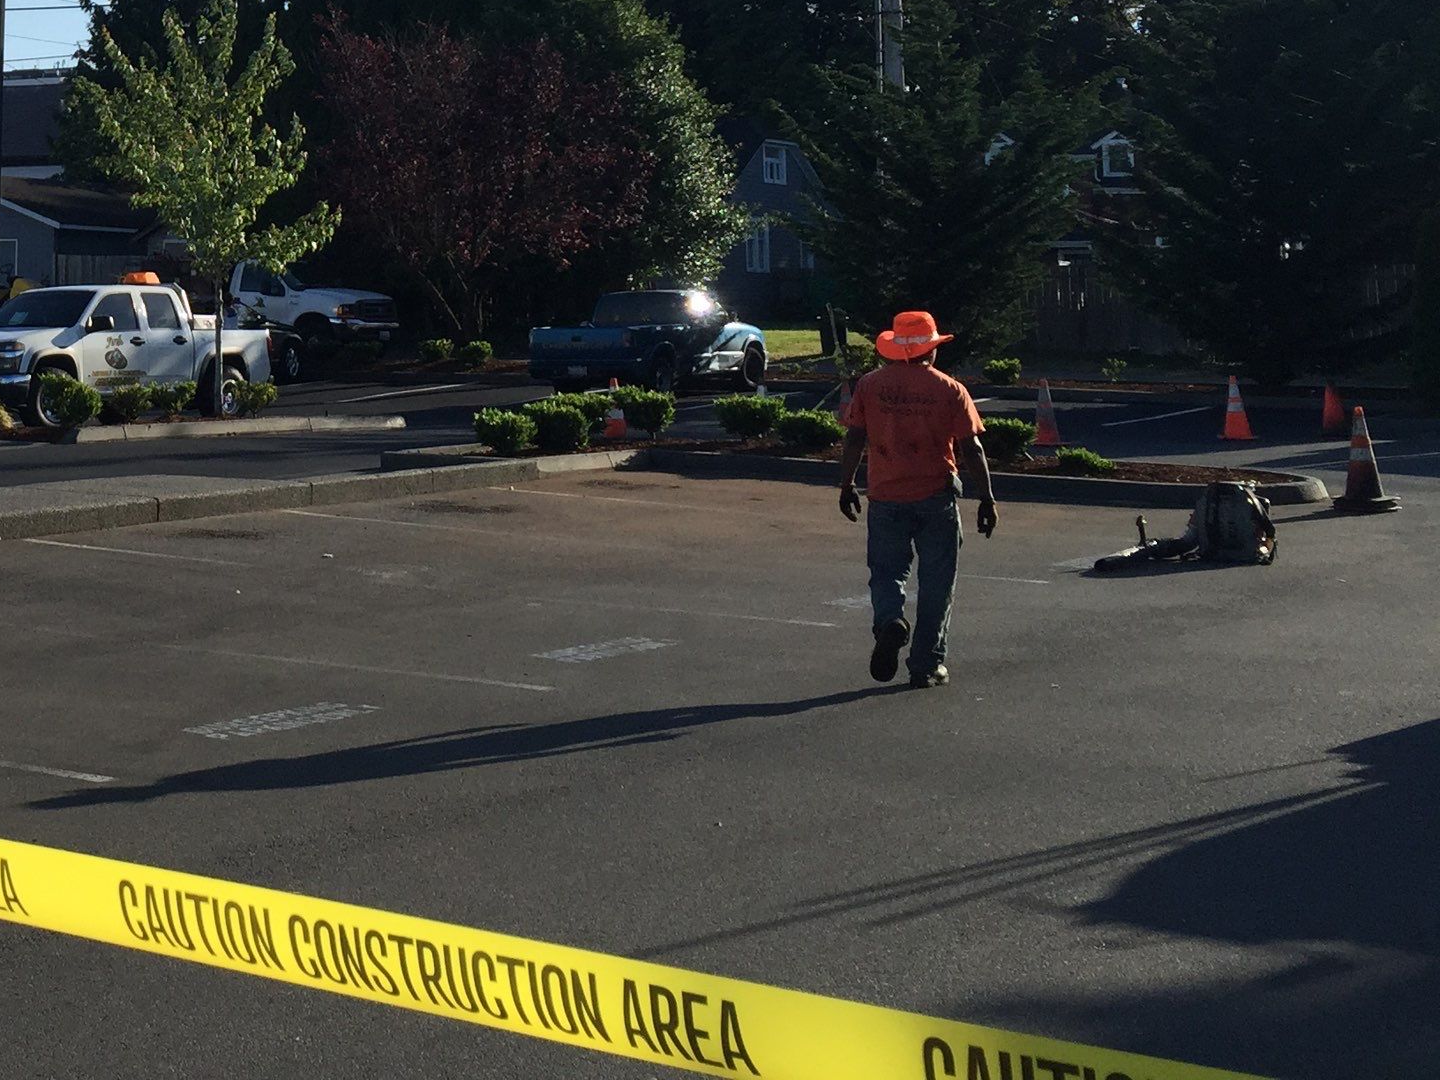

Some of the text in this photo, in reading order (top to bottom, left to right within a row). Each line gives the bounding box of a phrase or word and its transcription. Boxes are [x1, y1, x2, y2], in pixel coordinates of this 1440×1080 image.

[119, 879, 761, 1076] CAUTION CONSTRUCTION AREA
